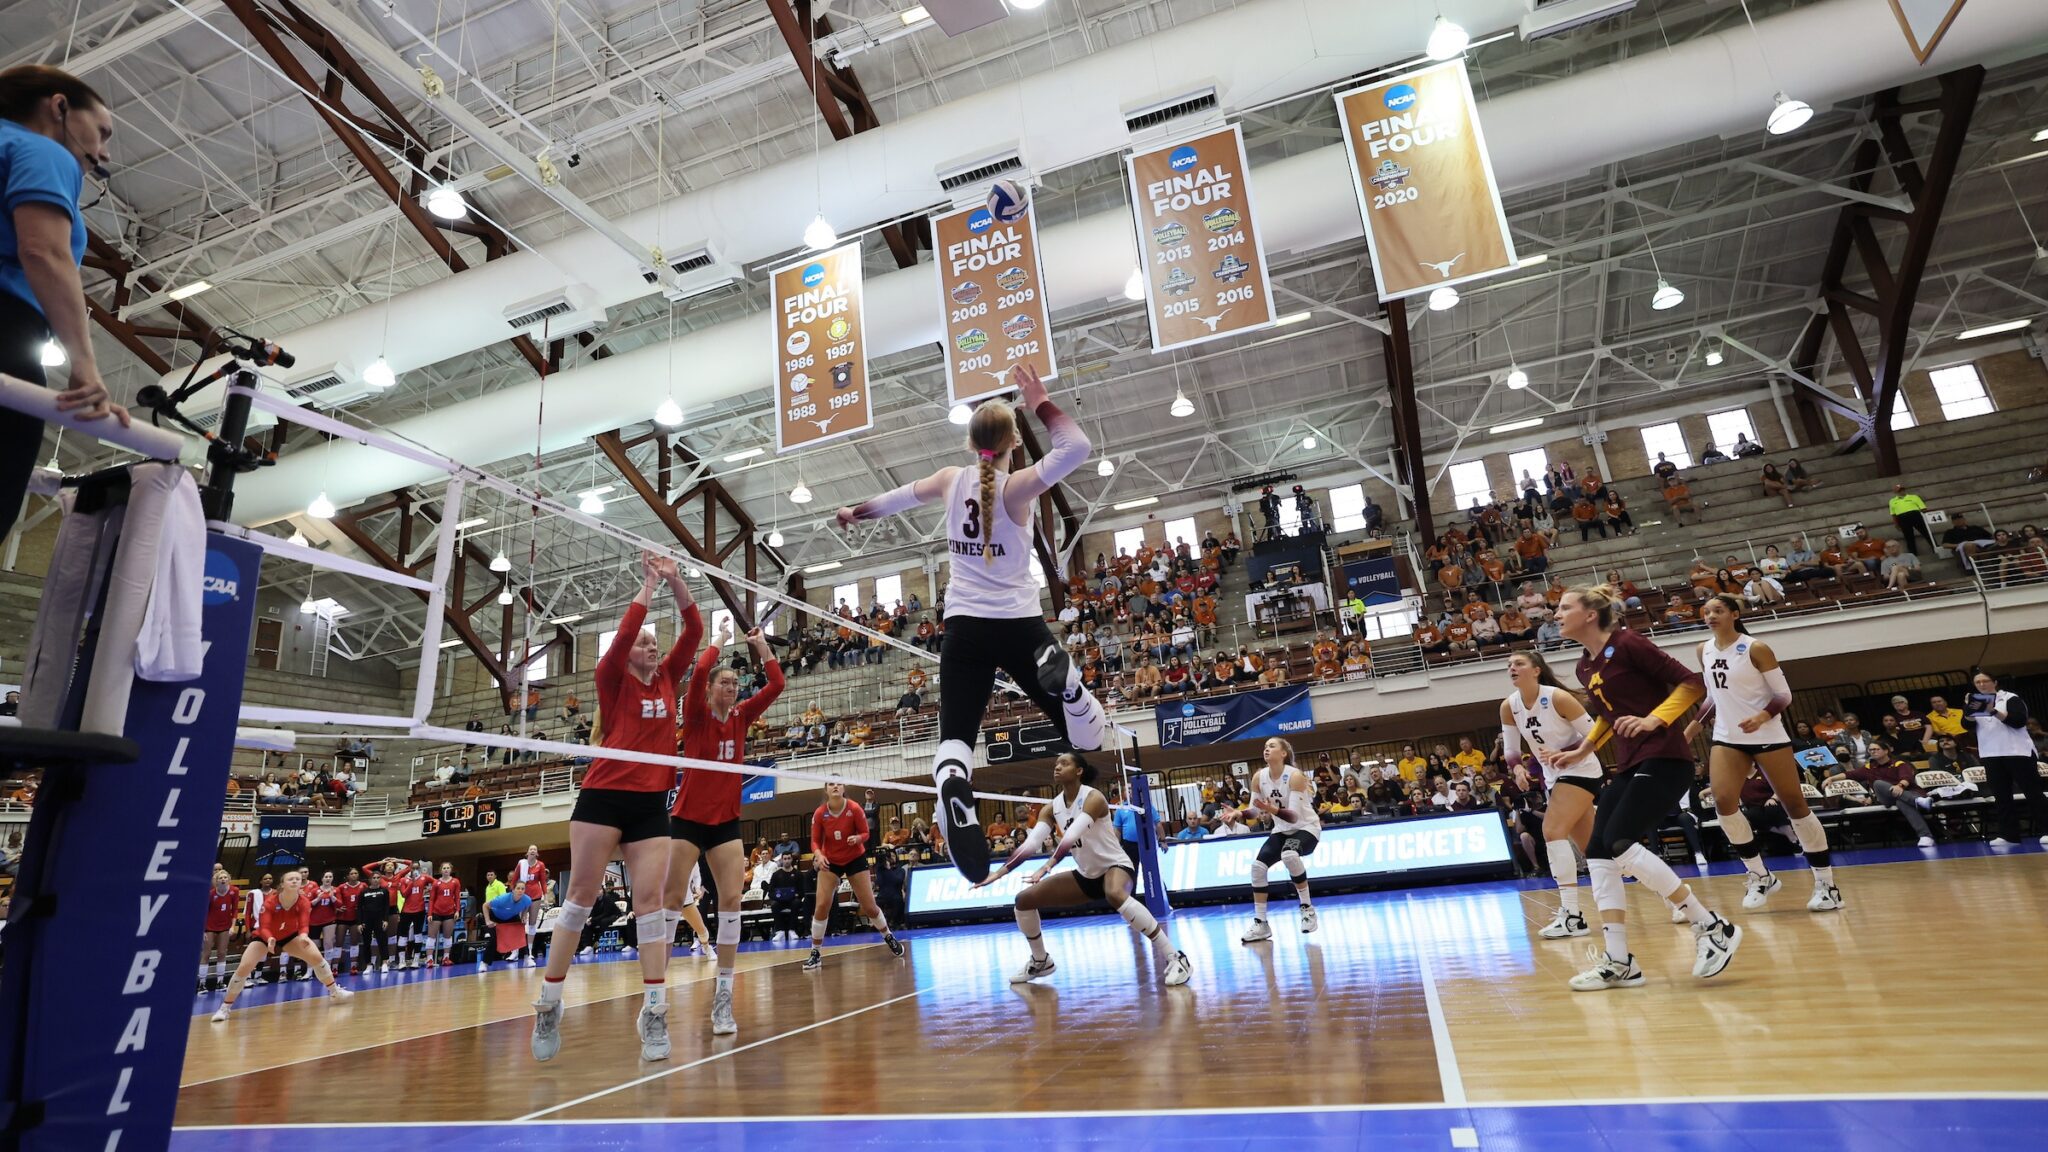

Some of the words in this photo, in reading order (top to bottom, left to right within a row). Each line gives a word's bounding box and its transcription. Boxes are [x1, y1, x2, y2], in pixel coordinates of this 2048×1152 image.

[1388, 93, 1416, 107] NCAA
[1369, 122, 1458, 159] FOUR
[1172, 155, 1197, 168] NCAA
[1148, 165, 1232, 200] FINAL
[1153, 182, 1232, 217] FOUR
[1374, 187, 1418, 210] 2020
[970, 217, 992, 230] NCAA
[948, 226, 1022, 260] FINAL
[1208, 231, 1245, 252] 2014
[953, 243, 1021, 277] FOUR
[1157, 245, 1191, 264] 2013
[784, 282, 849, 313] FINAL
[997, 288, 1034, 309] 2009
[1216, 285, 1253, 306] 2016
[787, 297, 848, 329] FOUR
[952, 302, 987, 323] 2008
[1164, 298, 1199, 318] 2015
[825, 341, 854, 360] 1987
[1006, 341, 1039, 360] 2012
[785, 355, 814, 372] 1986
[959, 354, 991, 373] 2010
[829, 391, 859, 409] 1995
[787, 404, 816, 421] 1988
[963, 498, 980, 538] 3
[948, 539, 1006, 556] INNESTA
[203, 576, 237, 596] CAA
[1358, 571, 1395, 584] VOLLEYBALL
[1713, 672, 1728, 689] 12
[1183, 716, 1226, 730] VOLLEYBALL
[1183, 726, 1222, 736] CHAMPIONSHIP
[1278, 719, 1312, 731] #NCAAVB
[995, 732, 1009, 741] OSU
[1531, 730, 1545, 744] 5
[718, 740, 735, 760] 16
[1918, 772, 1952, 780] TEXAS
[1965, 769, 1986, 777] TEX
[750, 791, 773, 800] #NCAAVB
[485, 812, 495, 825] 15
[271, 829, 306, 838] WELCOME
[834, 831, 841, 840] 8
